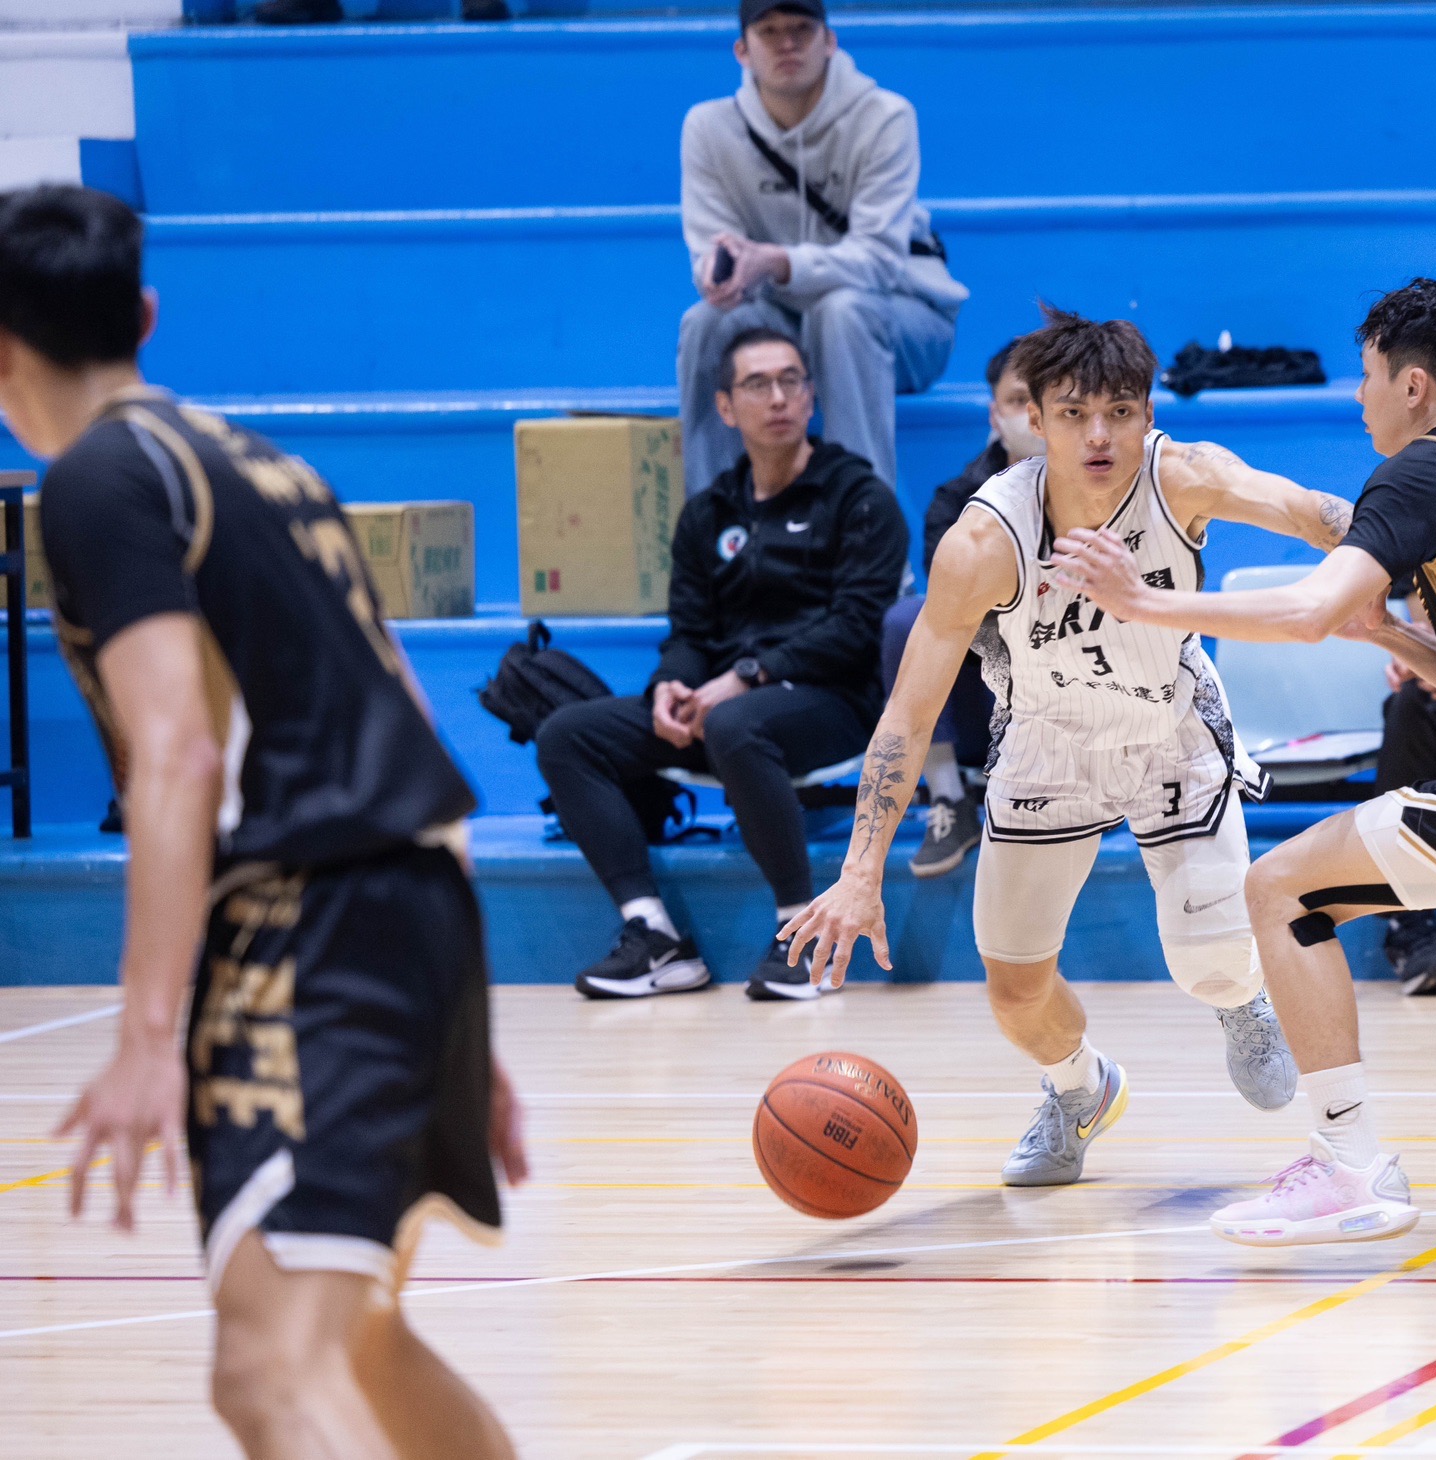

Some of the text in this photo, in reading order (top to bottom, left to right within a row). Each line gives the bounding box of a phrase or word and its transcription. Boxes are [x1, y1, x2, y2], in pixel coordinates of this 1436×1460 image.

[1082, 645, 1113, 677] 3
[1161, 781, 1182, 818] 3
[812, 1056, 912, 1127] SPALDING
[823, 1119, 859, 1151] FIBA
